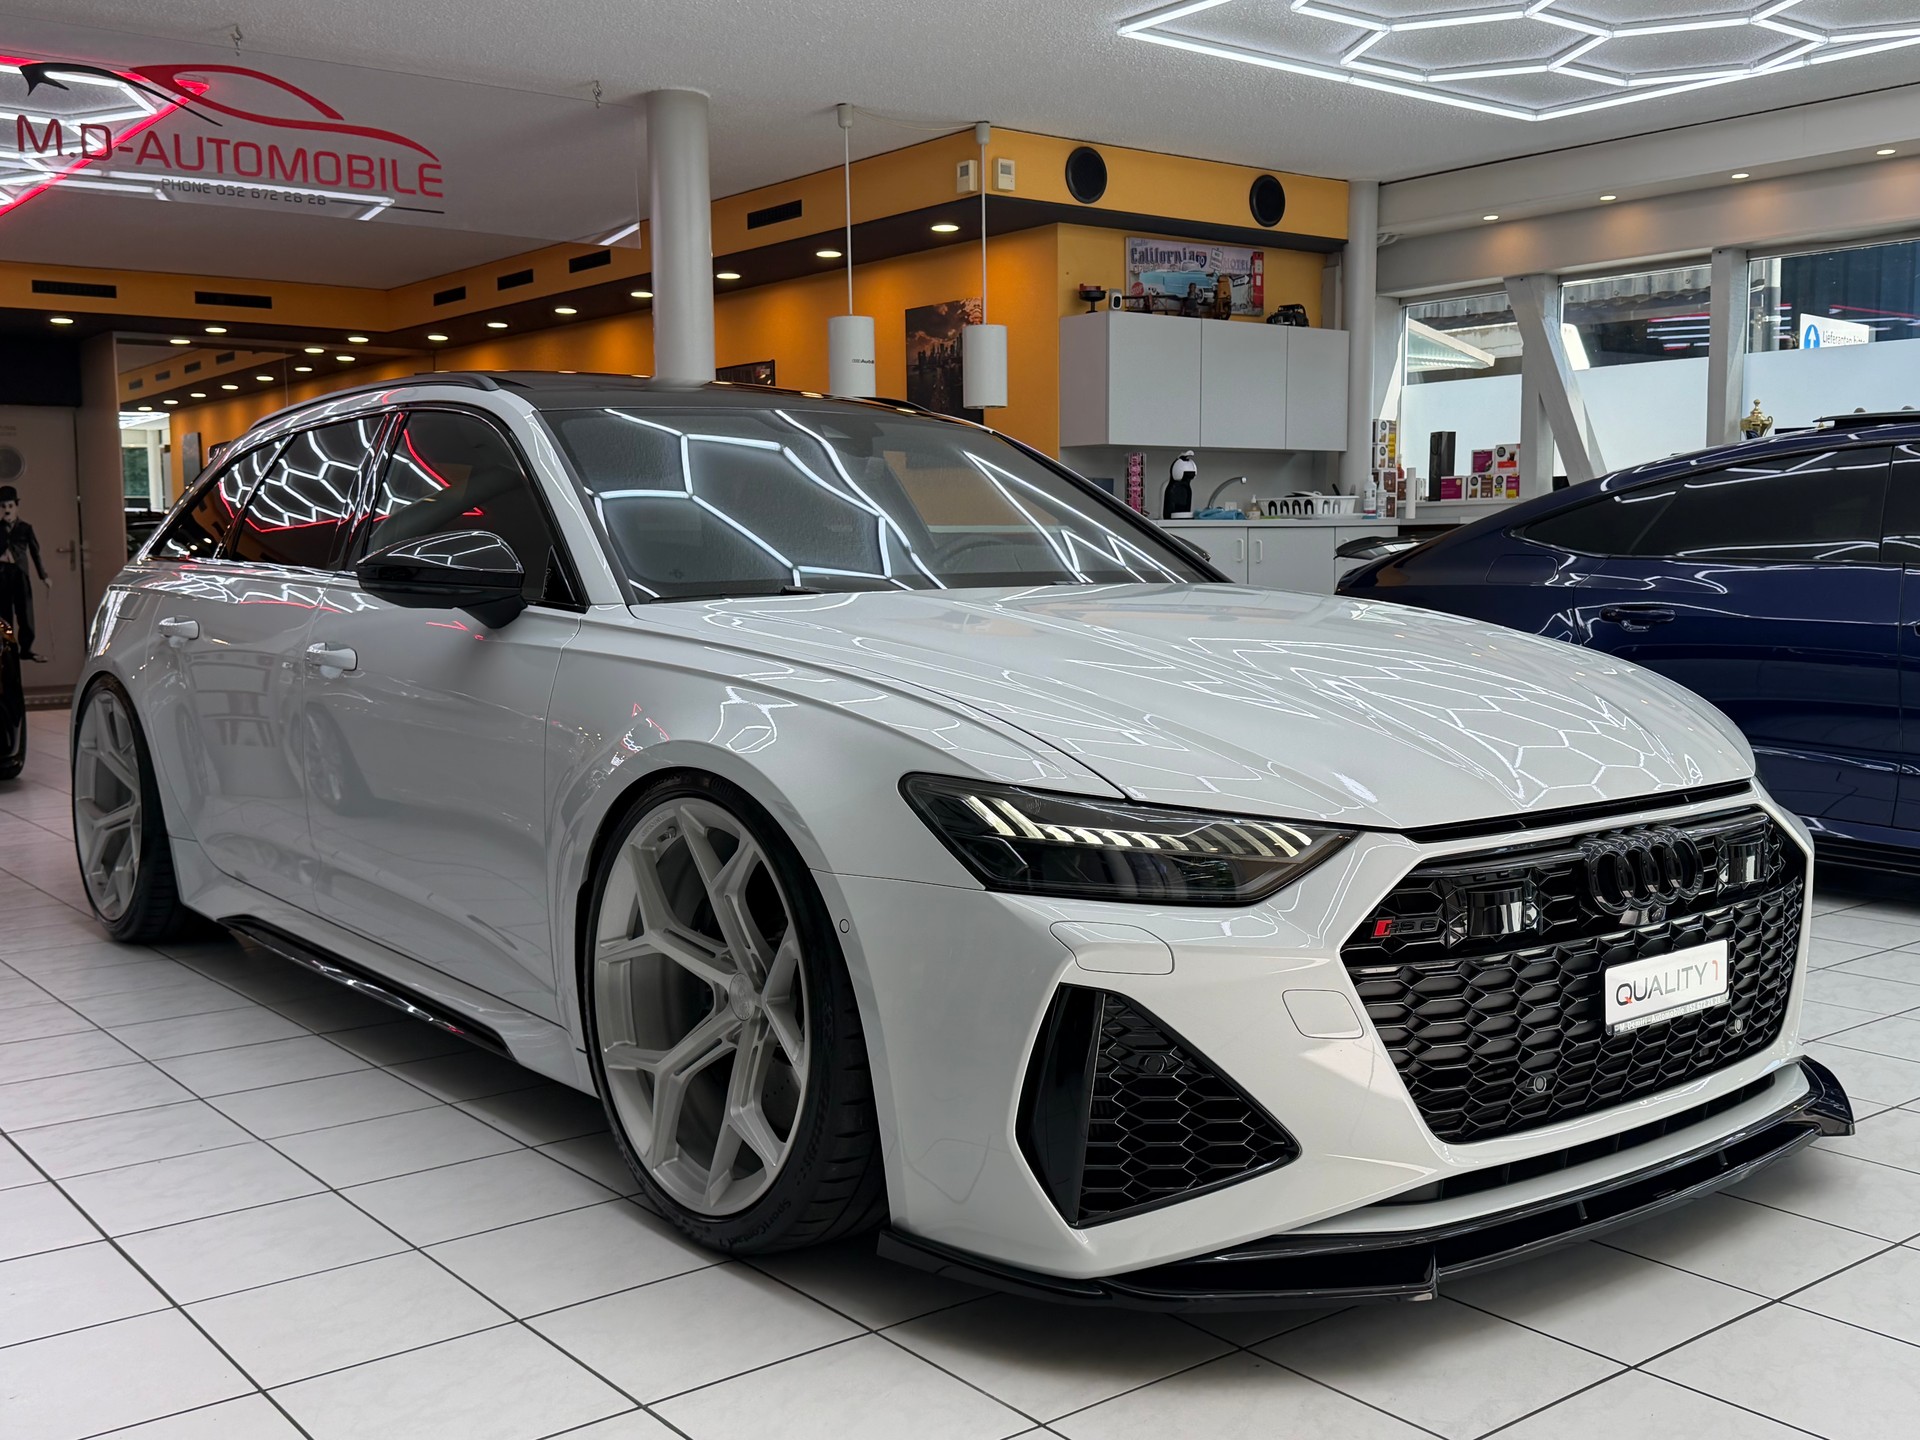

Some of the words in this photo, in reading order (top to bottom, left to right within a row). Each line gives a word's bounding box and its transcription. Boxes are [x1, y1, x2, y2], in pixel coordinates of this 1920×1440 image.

[17, 114, 443, 198] M.D-AUTOMOBILE
[161, 178, 211, 194] PHONE
[216, 184, 246, 197] 052
[251, 188, 278, 201] 672
[283, 190, 303, 204] 28
[307, 193, 327, 206] 28
[1131, 247, 1195, 265] California
[1374, 919, 1415, 936] RS
[1421, 919, 1438, 932] 6
[1615, 961, 1708, 1006] QUALITY
[1711, 959, 1719, 981] 1
